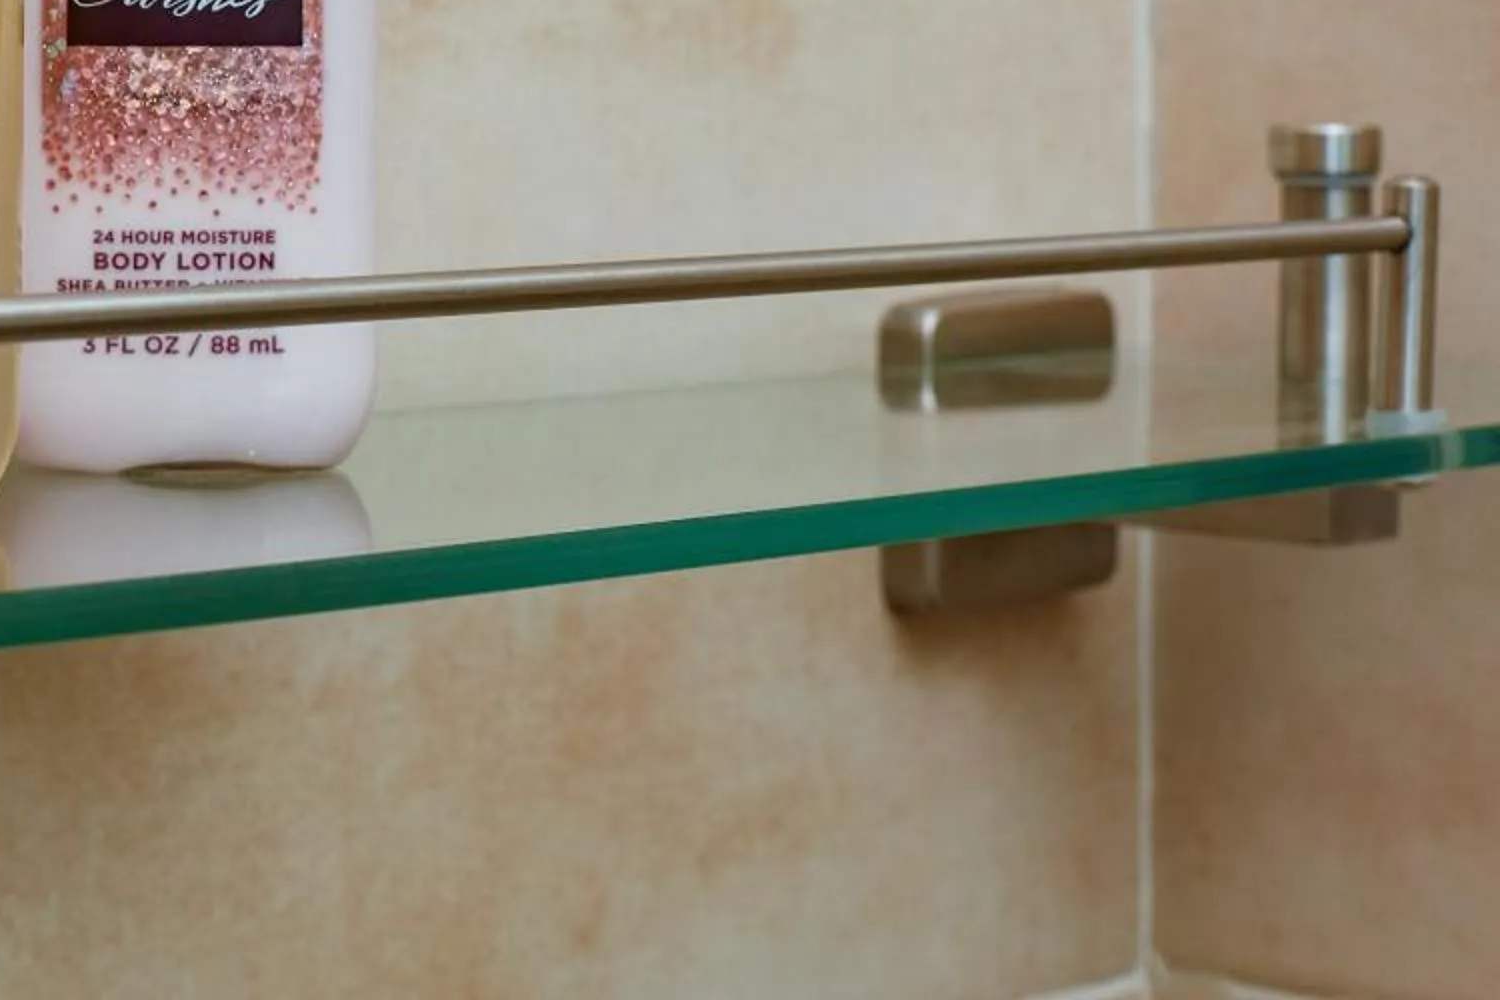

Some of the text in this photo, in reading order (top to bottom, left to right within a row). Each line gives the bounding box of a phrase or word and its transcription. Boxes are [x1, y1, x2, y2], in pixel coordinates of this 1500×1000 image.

[92, 229, 277, 245] 24 HOUR MOISTURE
[93, 251, 276, 271] BODY LOTION
[57, 278, 106, 293] SHEA
[83, 333, 286, 357] 3 FL OZ / 88 mL
